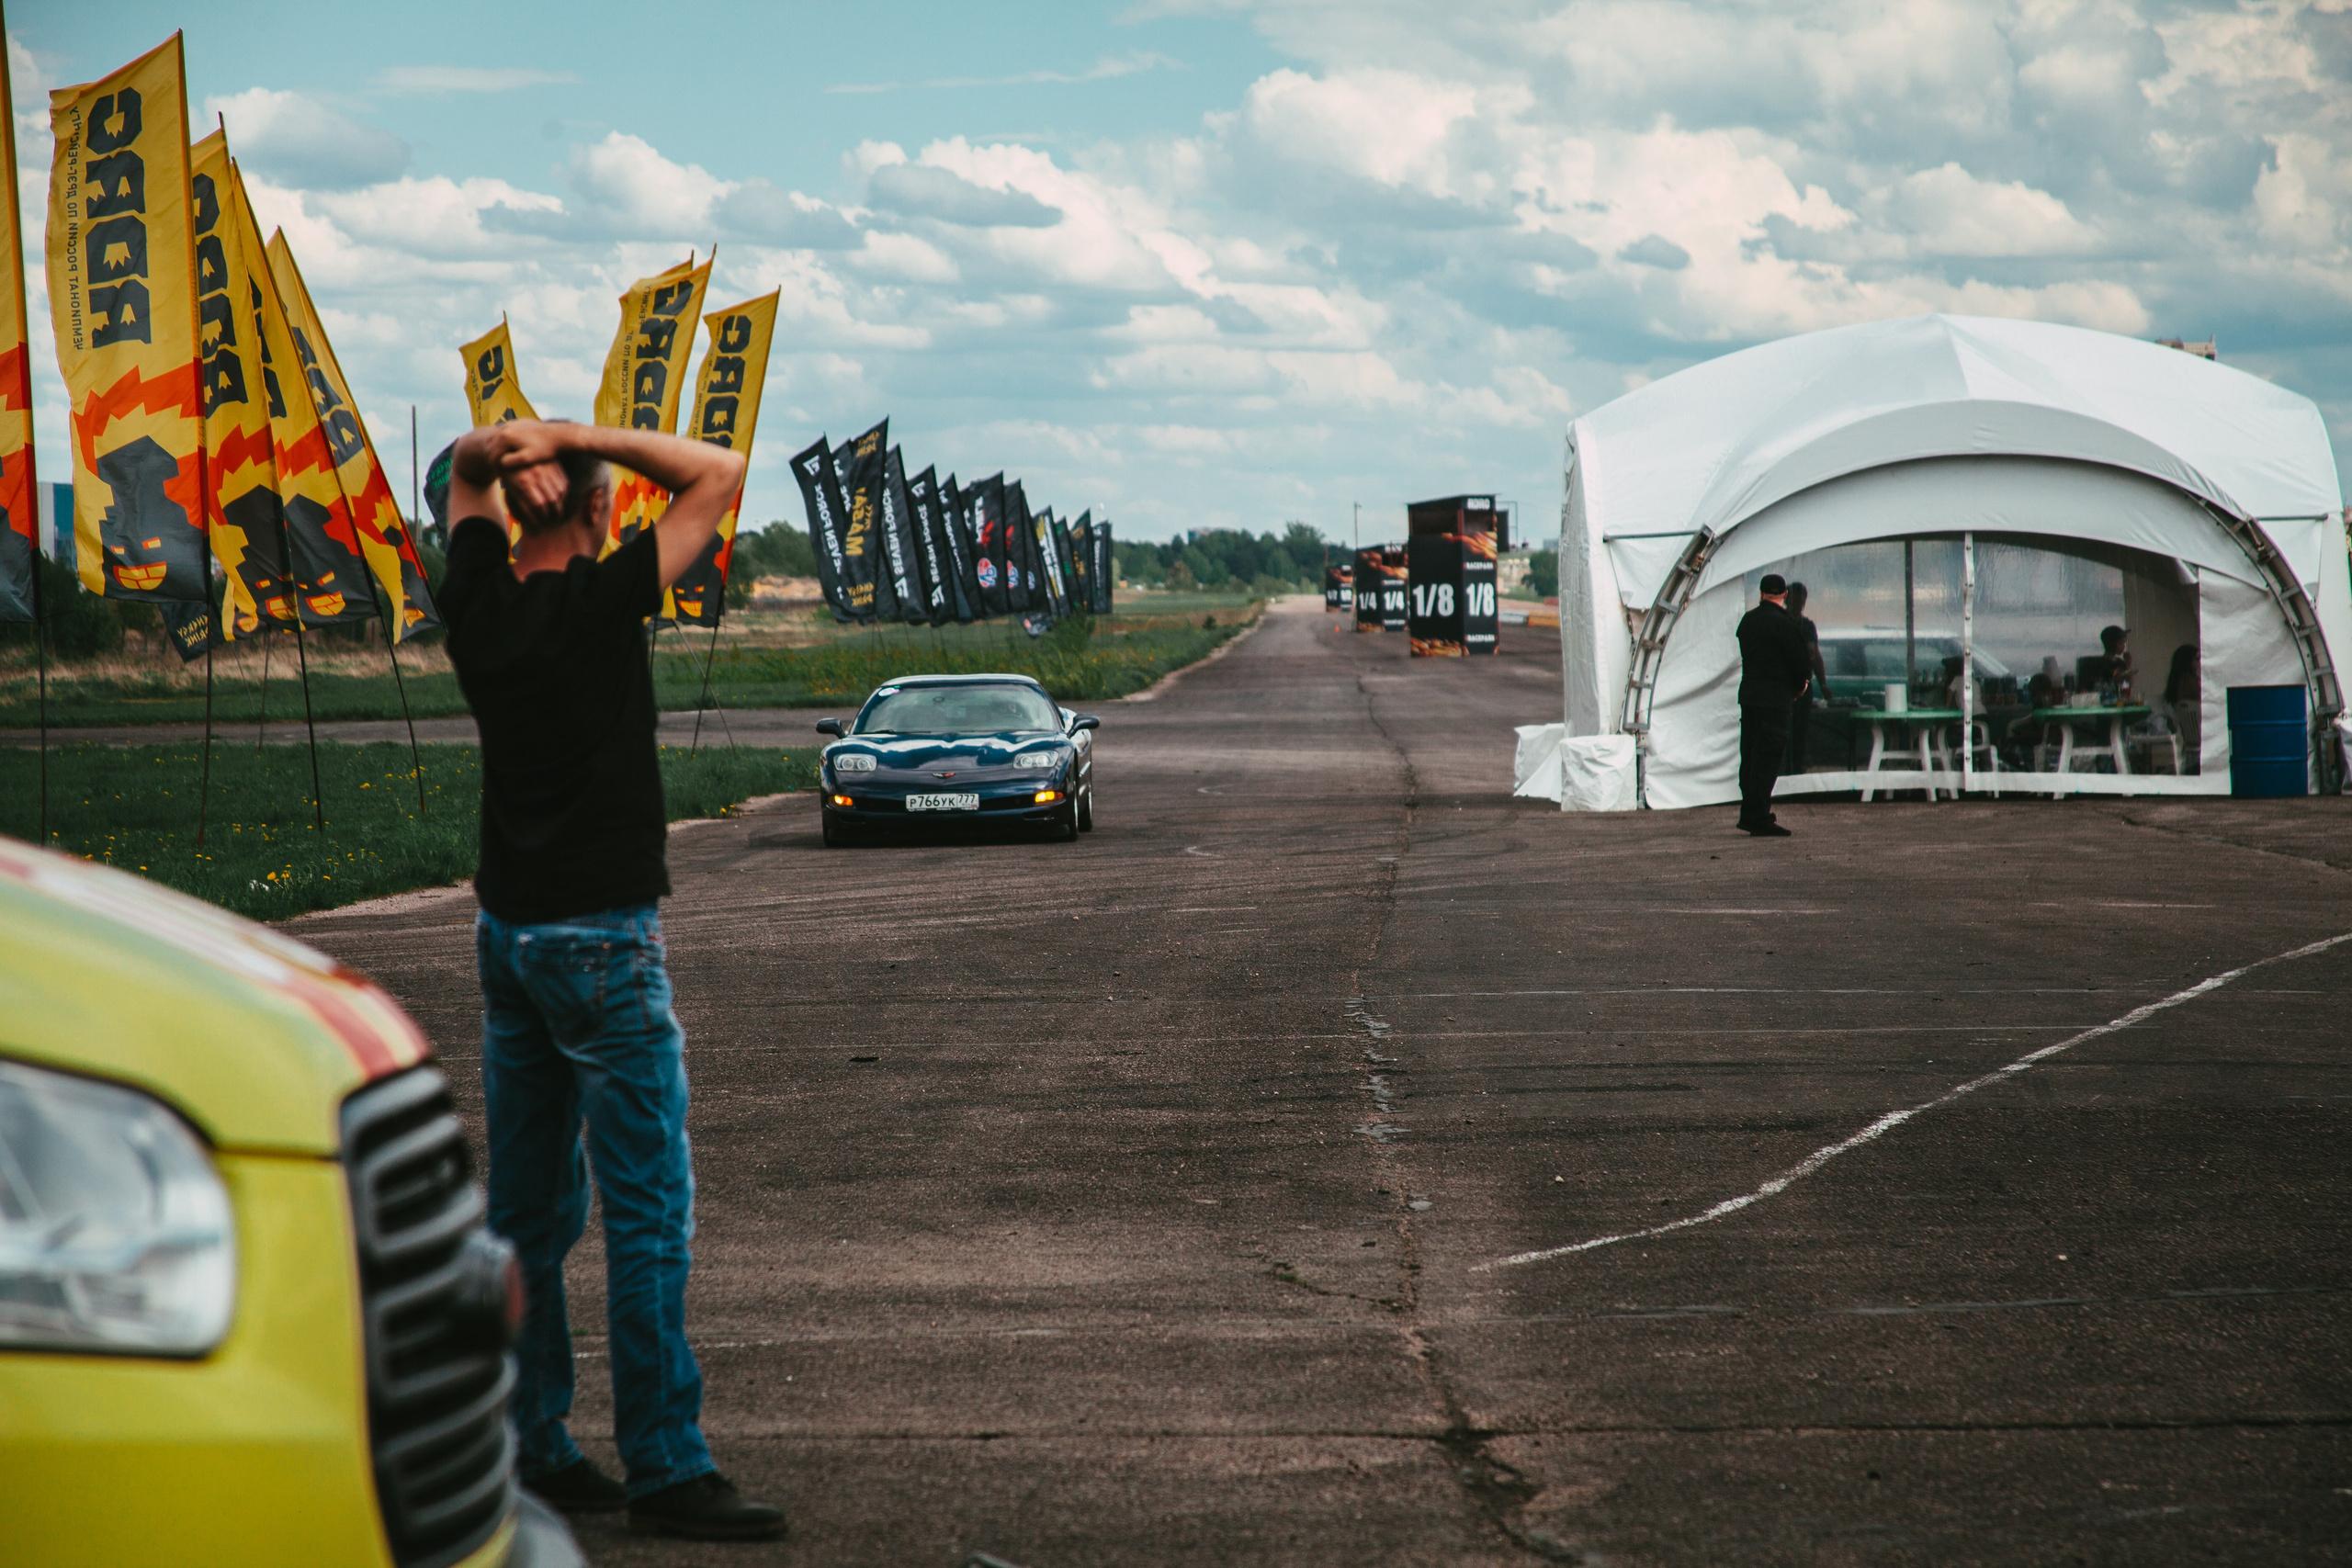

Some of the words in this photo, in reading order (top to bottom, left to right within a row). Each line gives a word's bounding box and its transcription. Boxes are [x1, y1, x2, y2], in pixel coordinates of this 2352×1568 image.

[1359, 592, 1376, 610] 1/4
[1385, 592, 1404, 611] 1/4
[1412, 584, 1453, 617] 1/8
[1466, 582, 1494, 616] 1/8
[958, 795, 975, 803] 777
